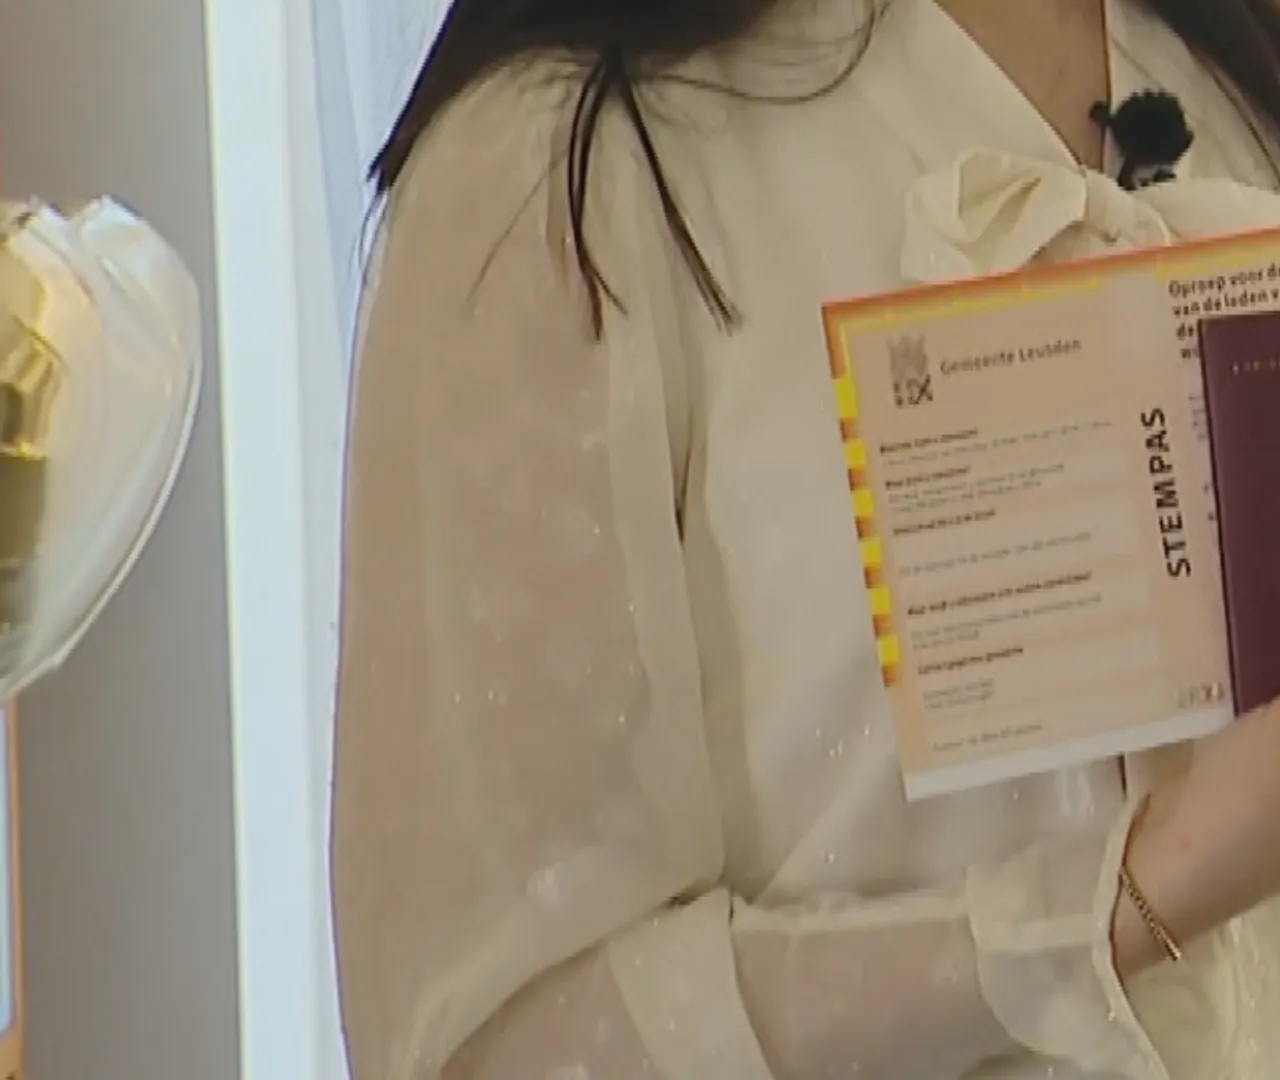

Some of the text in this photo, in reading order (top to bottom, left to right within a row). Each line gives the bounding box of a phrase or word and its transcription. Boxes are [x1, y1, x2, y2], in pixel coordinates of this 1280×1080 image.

[1168, 273, 1226, 299] Oproep
[1229, 268, 1264, 288] voor
[1172, 301, 1200, 317] van
[1202, 294, 1222, 312] de
[1224, 287, 1268, 309] leden
[940, 339, 1082, 375] Gemeente Leusden
[1141, 407, 1191, 579] STEMPAS
